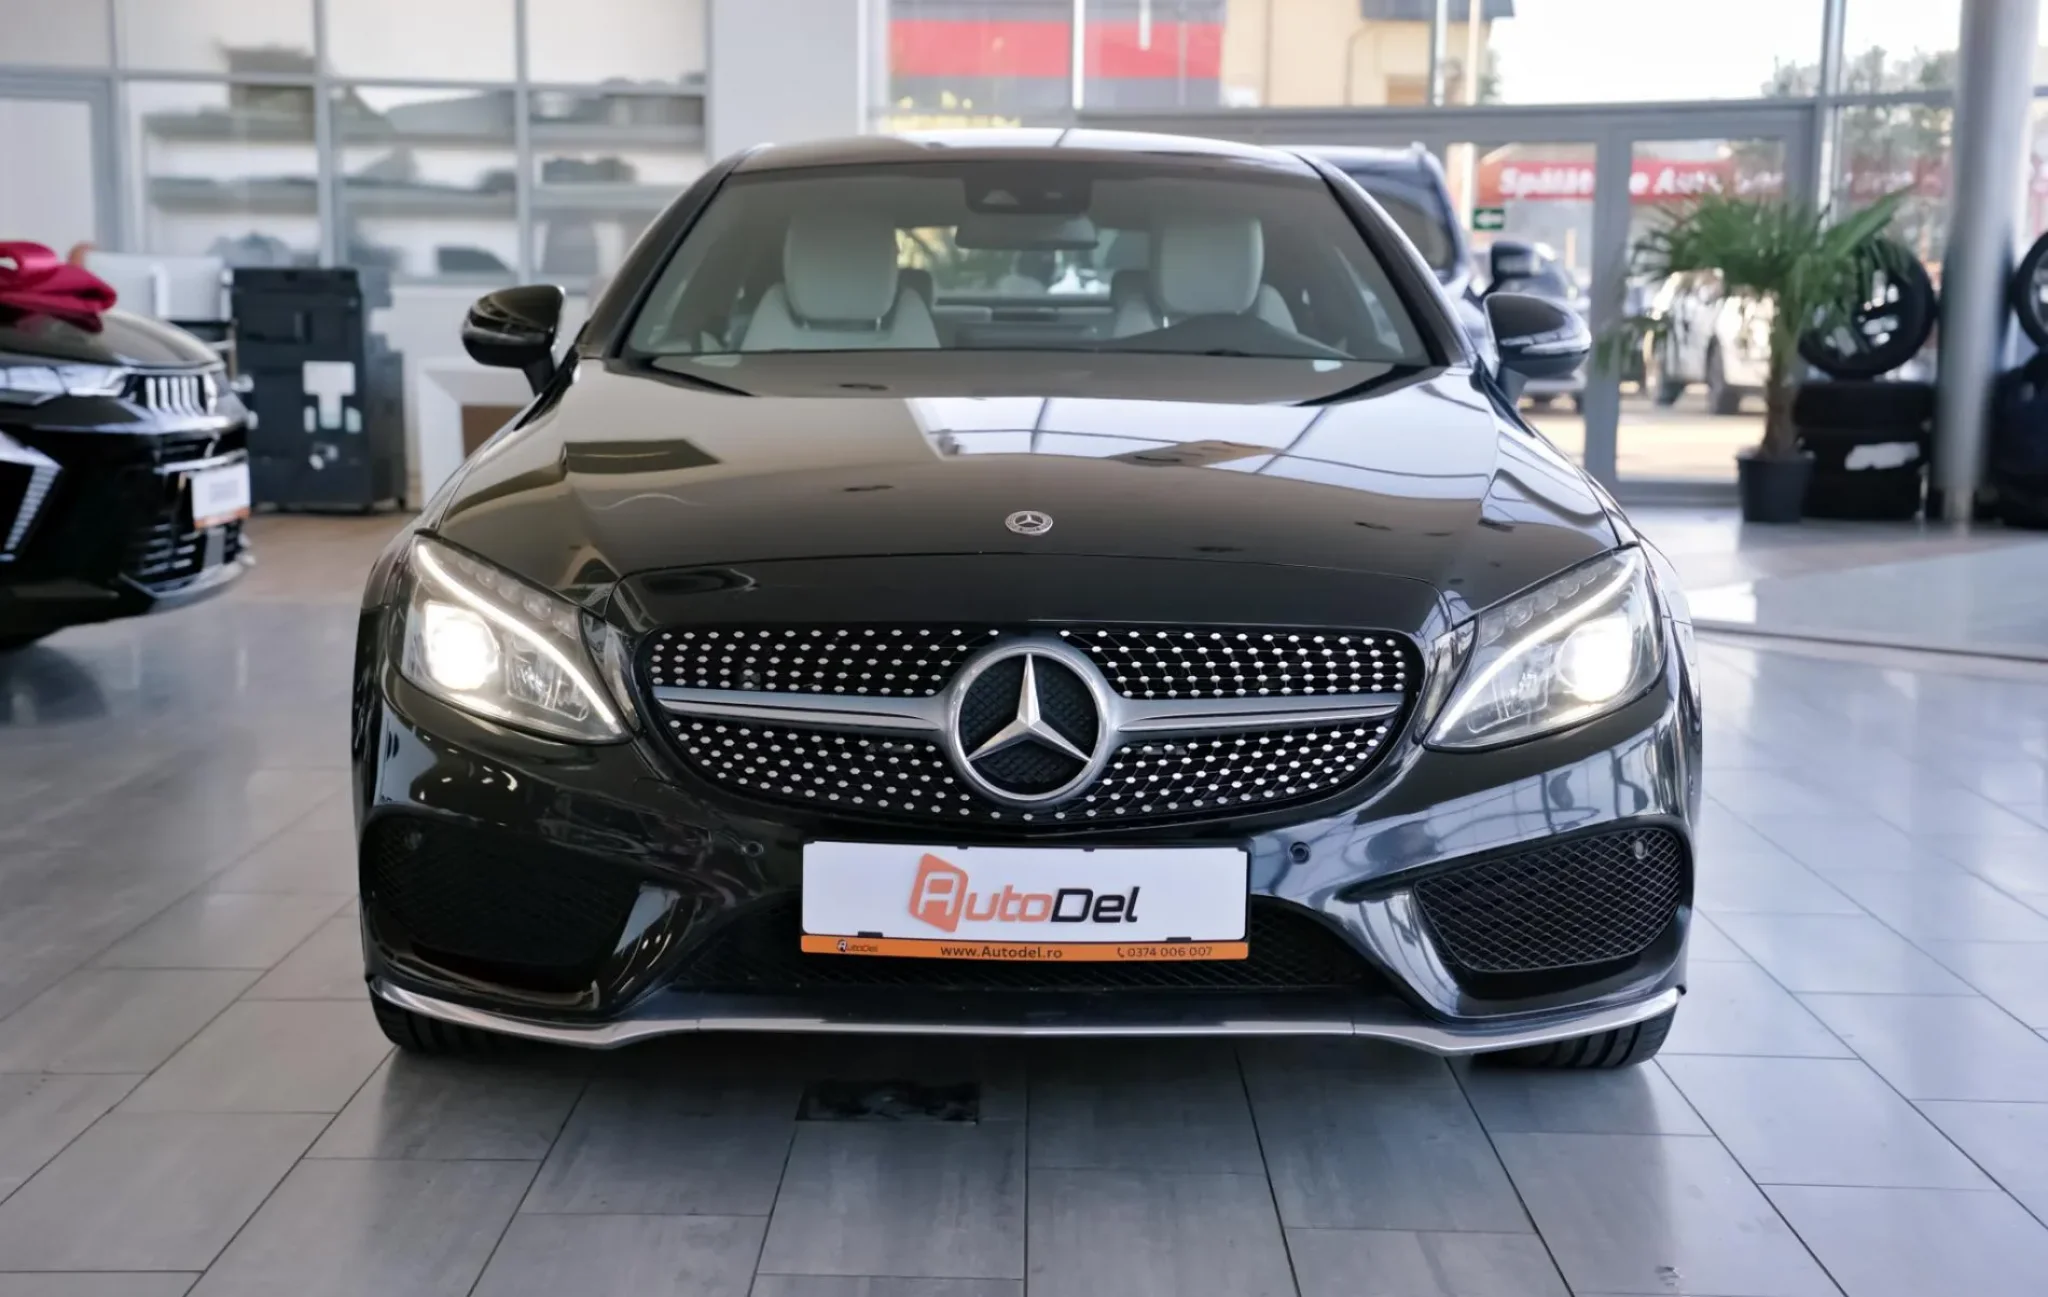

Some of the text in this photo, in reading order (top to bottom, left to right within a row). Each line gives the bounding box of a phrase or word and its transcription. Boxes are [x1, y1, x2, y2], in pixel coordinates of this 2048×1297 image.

[909, 853, 1140, 932] AutoDel
[940, 946, 1063, 958] www.Autodel.ro
[1127, 946, 1213, 957] 0374 006 007
